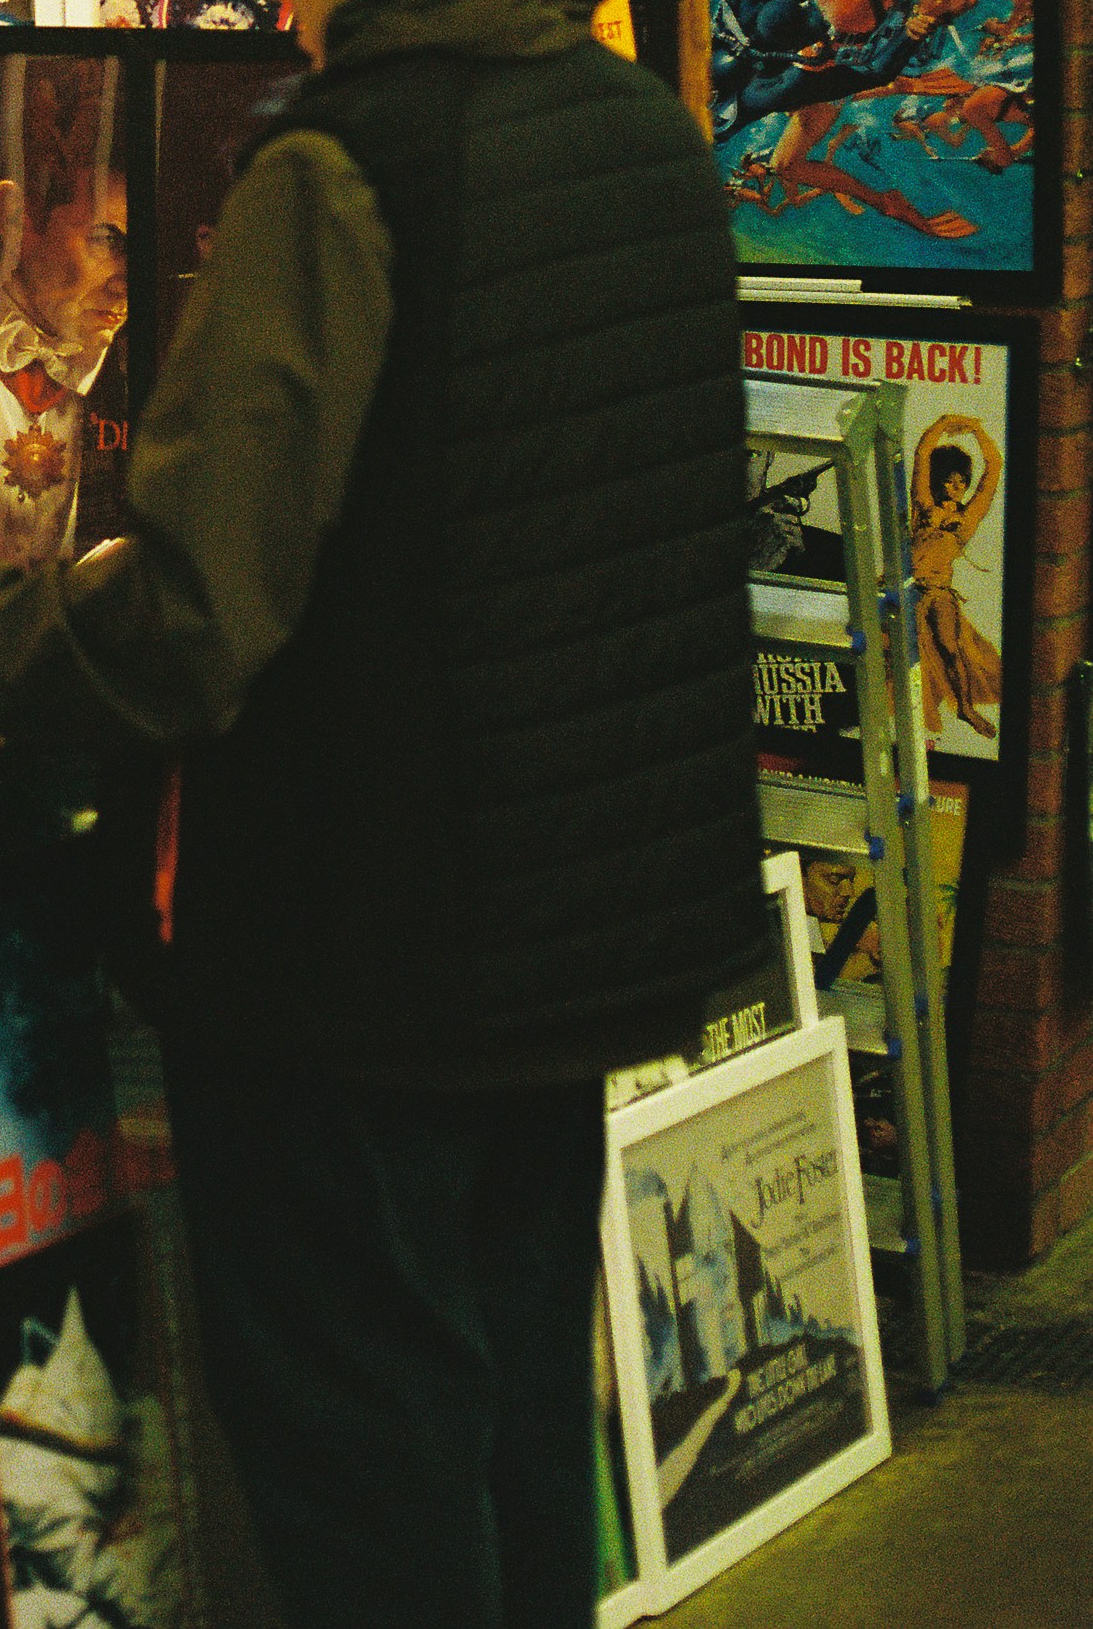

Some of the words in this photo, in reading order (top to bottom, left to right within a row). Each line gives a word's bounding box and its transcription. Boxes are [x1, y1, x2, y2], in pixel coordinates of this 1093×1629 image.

[744, 331, 829, 376] BOND
[842, 337, 872, 379] IS
[885, 340, 982, 386] BACK!
